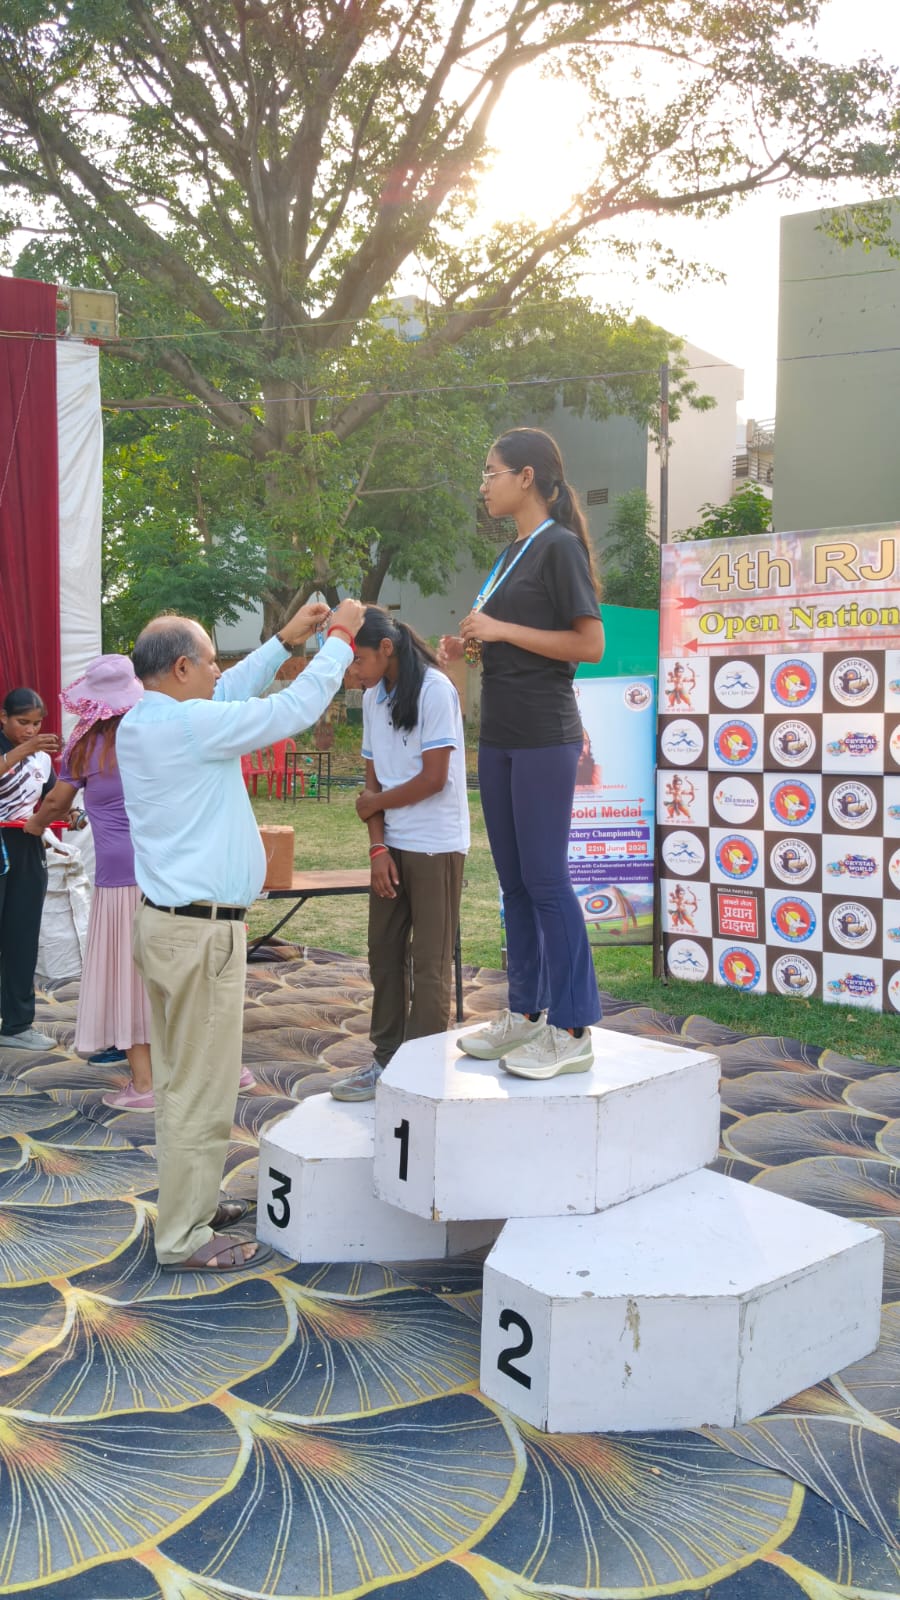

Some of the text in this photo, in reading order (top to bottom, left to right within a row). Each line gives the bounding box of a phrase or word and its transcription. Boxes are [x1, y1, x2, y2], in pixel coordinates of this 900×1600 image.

[700, 550, 792, 592] 4th
[698, 611, 780, 639] Open
[601, 805, 642, 818] Medal
[592, 829, 643, 839] Championship
[721, 918, 756, 933] टाइम्स
[723, 906, 753, 920] प्रधान
[394, 1118, 410, 1182] 1
[266, 1166, 292, 1229] 3
[497, 1308, 533, 1390] 2
